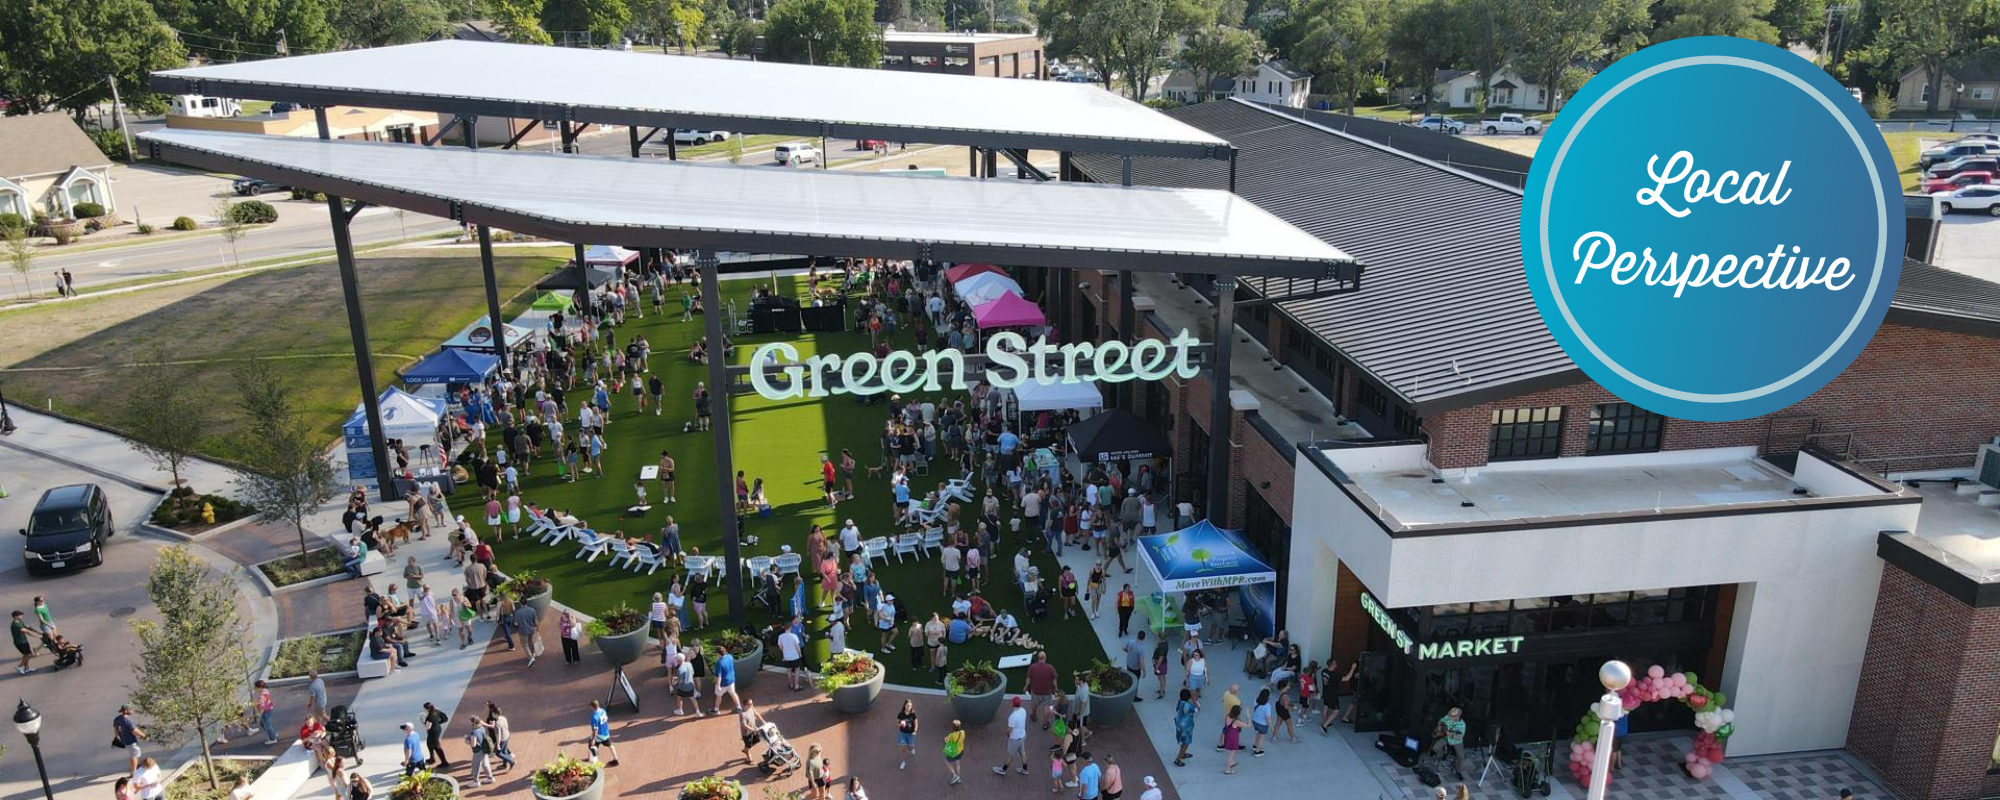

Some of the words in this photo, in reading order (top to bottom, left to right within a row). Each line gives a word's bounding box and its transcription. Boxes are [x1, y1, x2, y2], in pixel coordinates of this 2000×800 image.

[749, 342, 969, 400] Green
[985, 328, 1200, 388] Street
[1175, 575, 1266, 590] MoveWithMPR.com
[1360, 592, 1397, 640] GREEN
[1396, 629, 1413, 655] ST
[1418, 636, 1525, 661] MARKET
